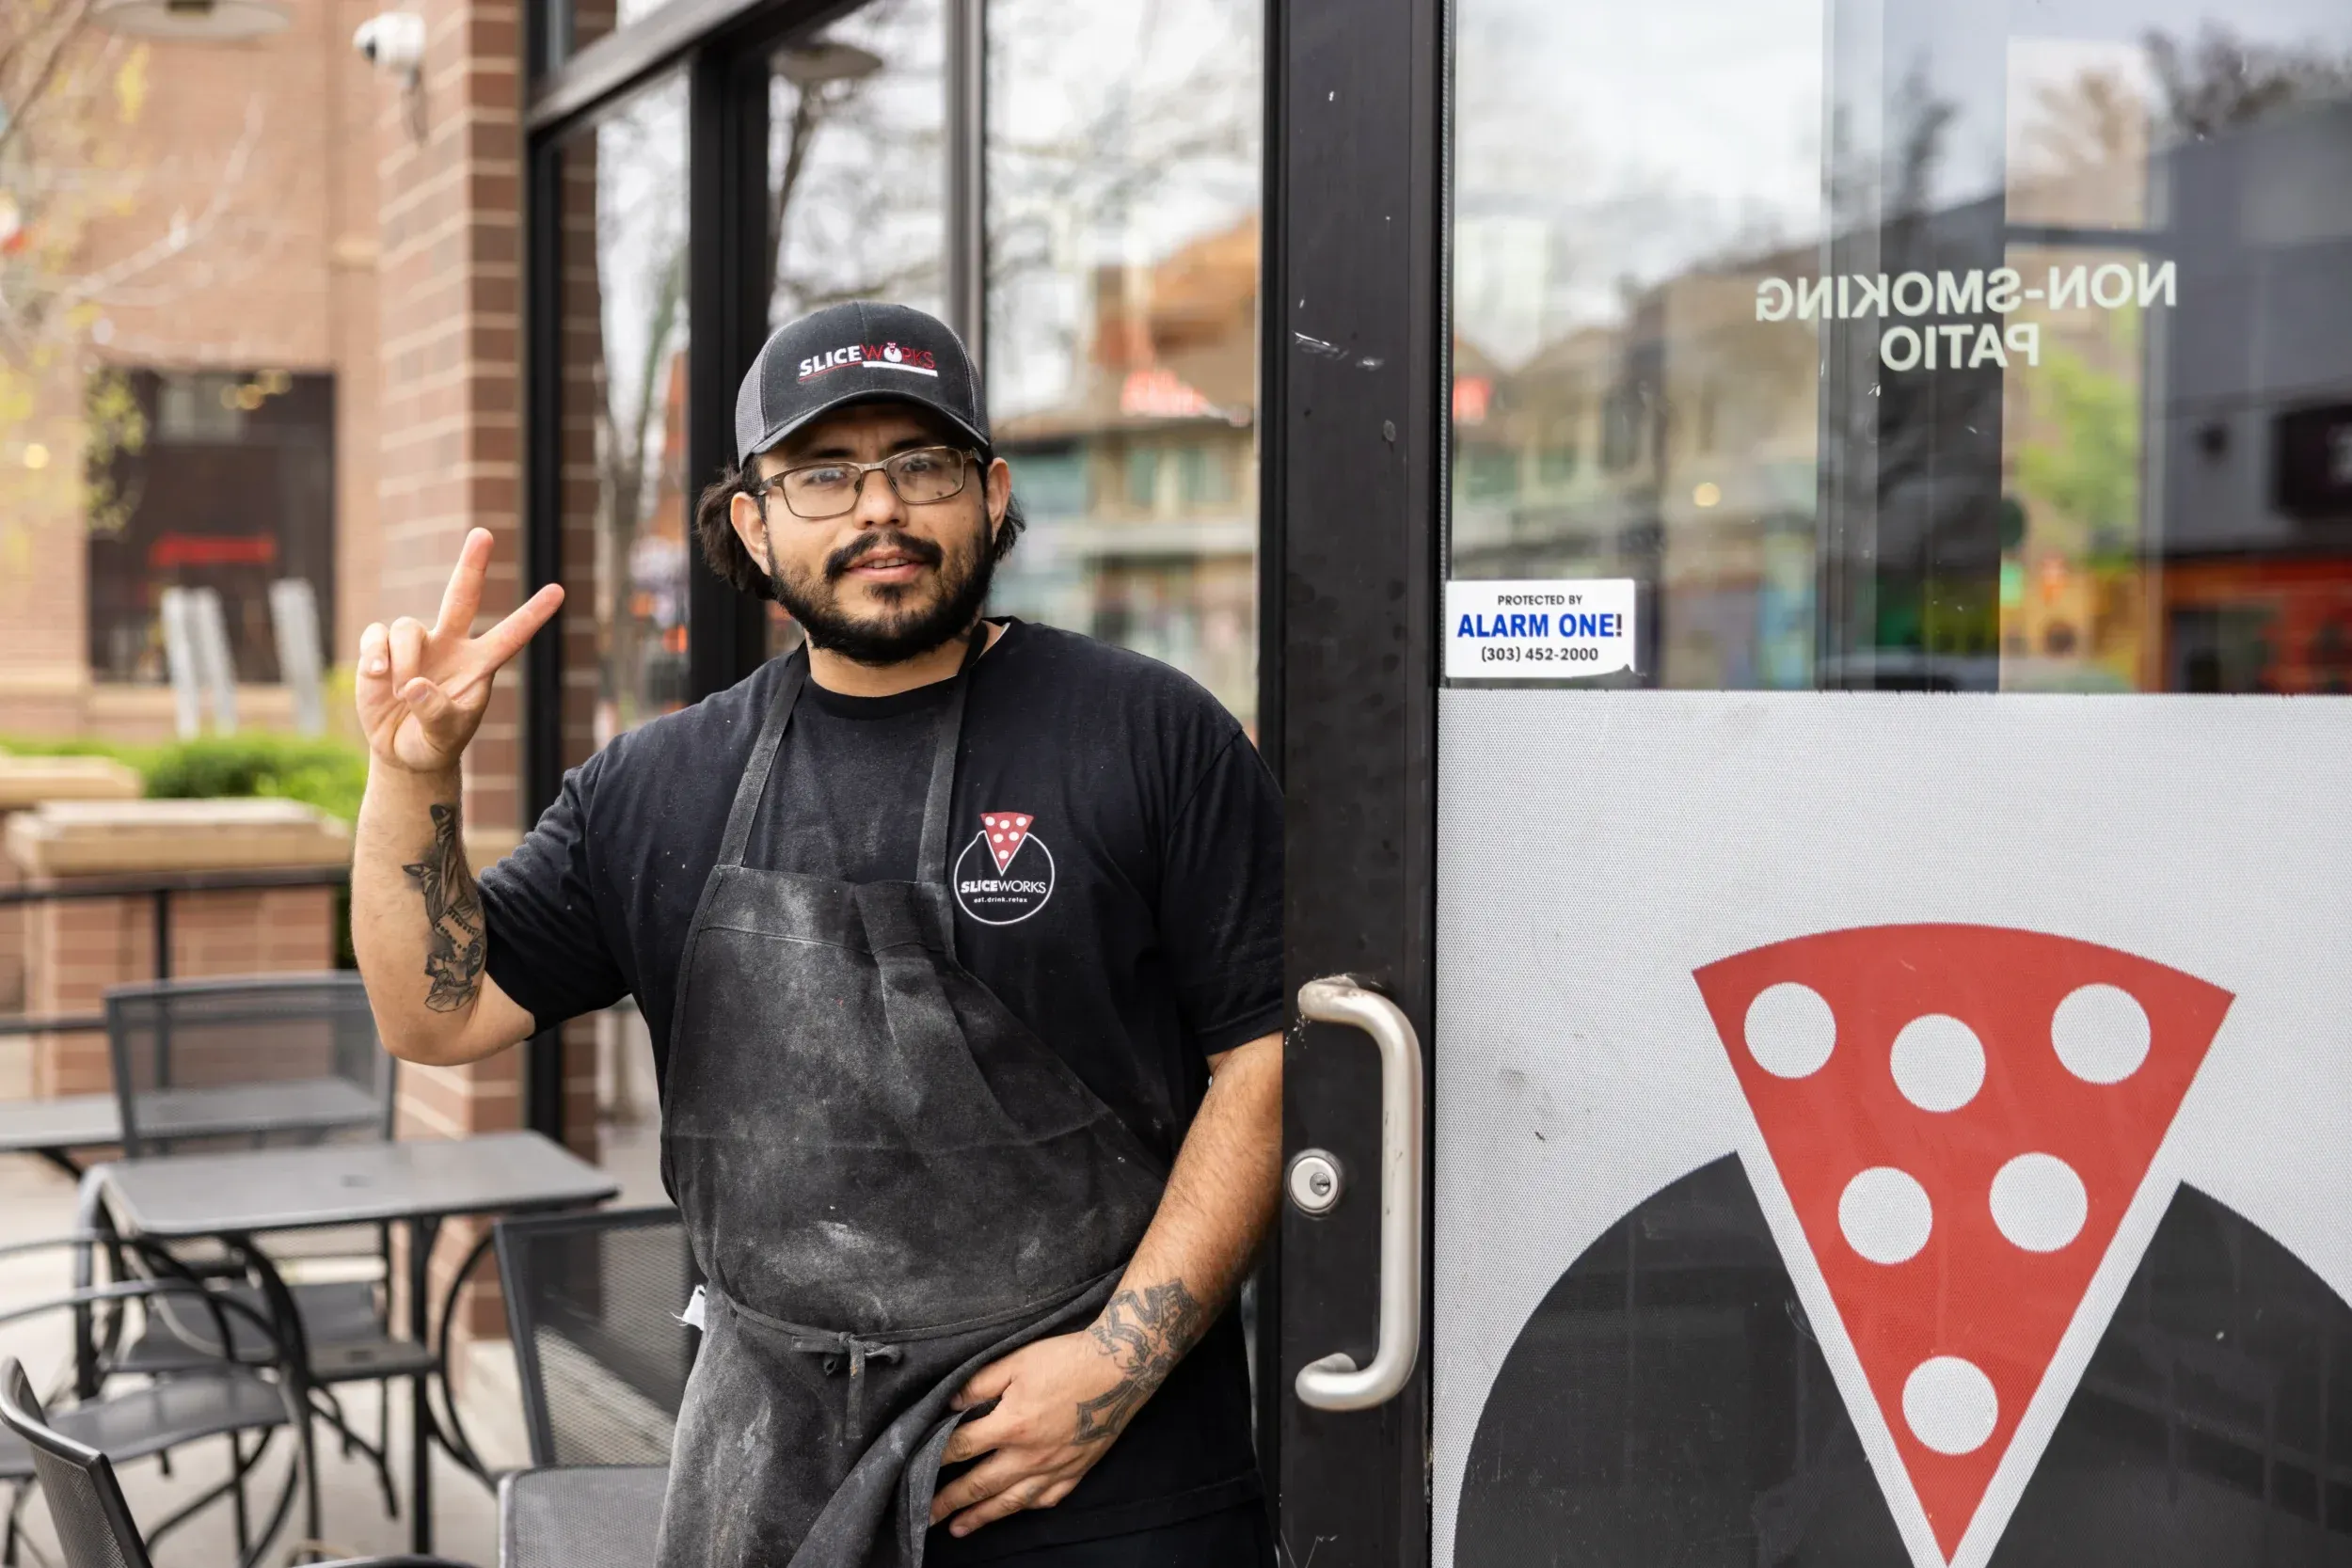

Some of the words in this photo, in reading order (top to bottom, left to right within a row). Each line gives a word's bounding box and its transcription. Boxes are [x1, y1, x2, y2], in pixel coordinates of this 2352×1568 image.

[1497, 594, 1565, 606] PROTECTED
[1568, 594, 1583, 606] BY
[1456, 613, 1549, 638] ALARM
[1558, 613, 1623, 638] ONE!
[1481, 646, 1521, 662] (303)
[1525, 647, 1599, 661] 452-2000
[961, 879, 1046, 894] SLICEWORKS
